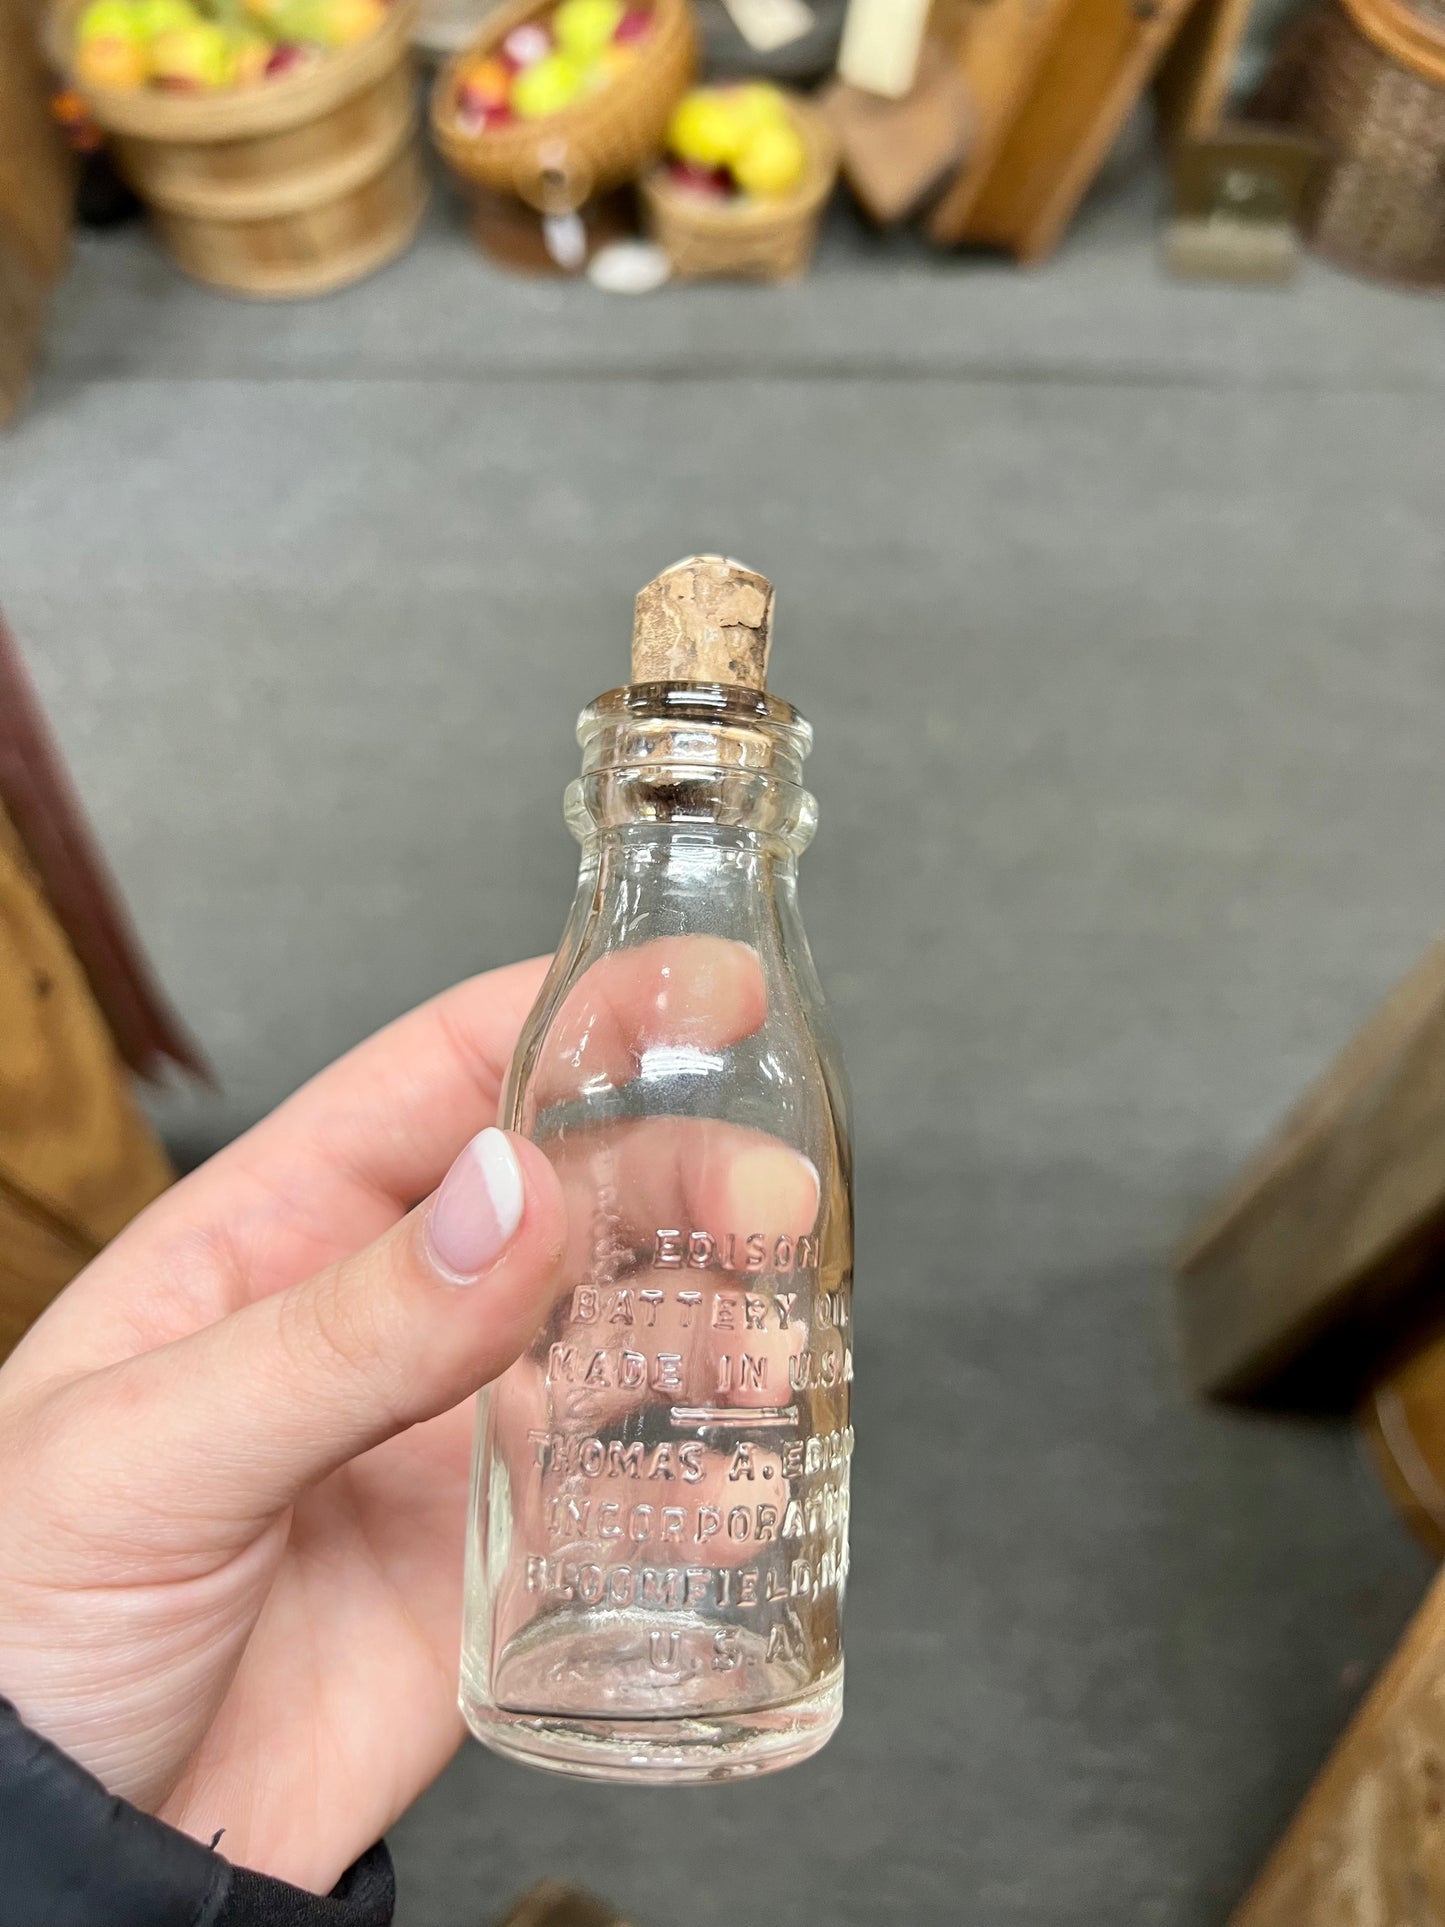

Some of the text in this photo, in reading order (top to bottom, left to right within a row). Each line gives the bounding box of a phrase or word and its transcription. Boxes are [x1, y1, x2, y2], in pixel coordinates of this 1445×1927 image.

[654, 1228, 821, 1272] EDISON
[571, 1284, 798, 1331] BATTERY
[548, 1342, 684, 1392] MADE
[717, 1353, 770, 1393] IN
[527, 1430, 707, 1484] THOMAS
